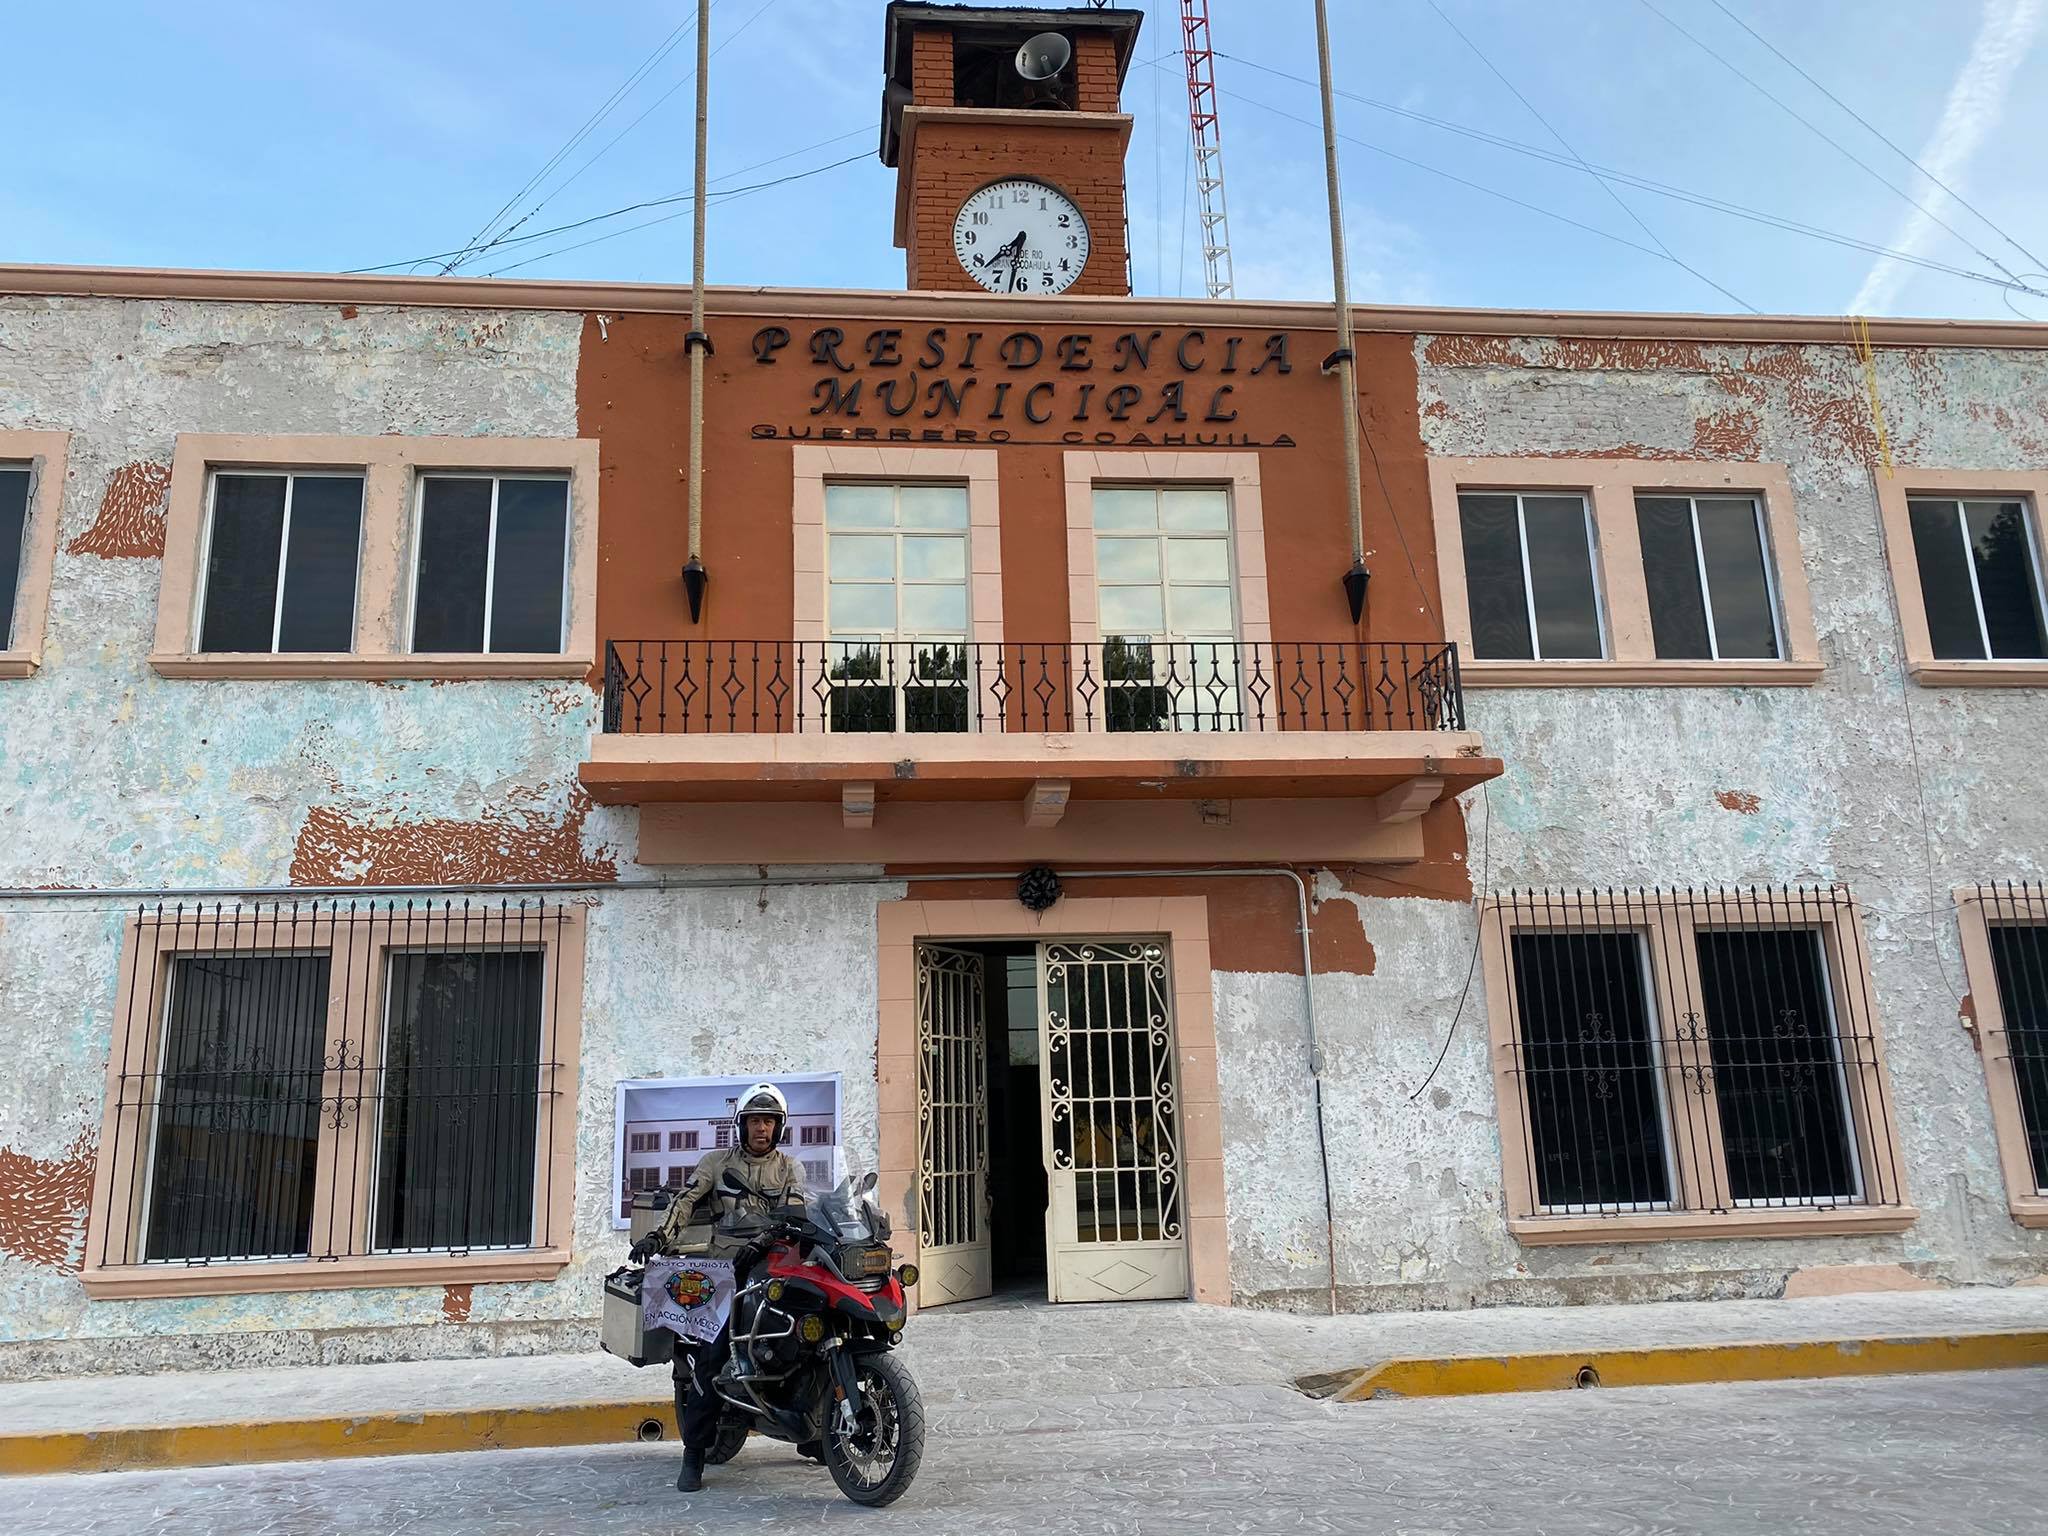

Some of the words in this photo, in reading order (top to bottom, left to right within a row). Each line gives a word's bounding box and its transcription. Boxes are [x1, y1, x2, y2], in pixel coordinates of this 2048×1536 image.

[989, 195, 1004, 209] 11
[1012, 190, 1029, 203] 12
[1038, 197, 1047, 211] 1
[972, 211, 988, 225] 10
[1058, 214, 1070, 228] 2
[965, 231, 976, 245] 9
[1066, 235, 1078, 249] 3
[973, 253, 985, 268] 8
[1032, 250, 1043, 260] RIO
[1058, 257, 1071, 271] 4
[992, 270, 1003, 283] 7
[1042, 272, 1054, 286] 5
[1016, 277, 1028, 292] 6
[752, 326, 1292, 374] PRESIDENCIA
[810, 371, 1238, 424] MUNICIPAL
[752, 424, 1011, 442] GUERRERO
[1062, 431, 1296, 447] COAHUILA
[645, 1312, 656, 1322] EN
[658, 1311, 692, 1324] ACCIÓN
